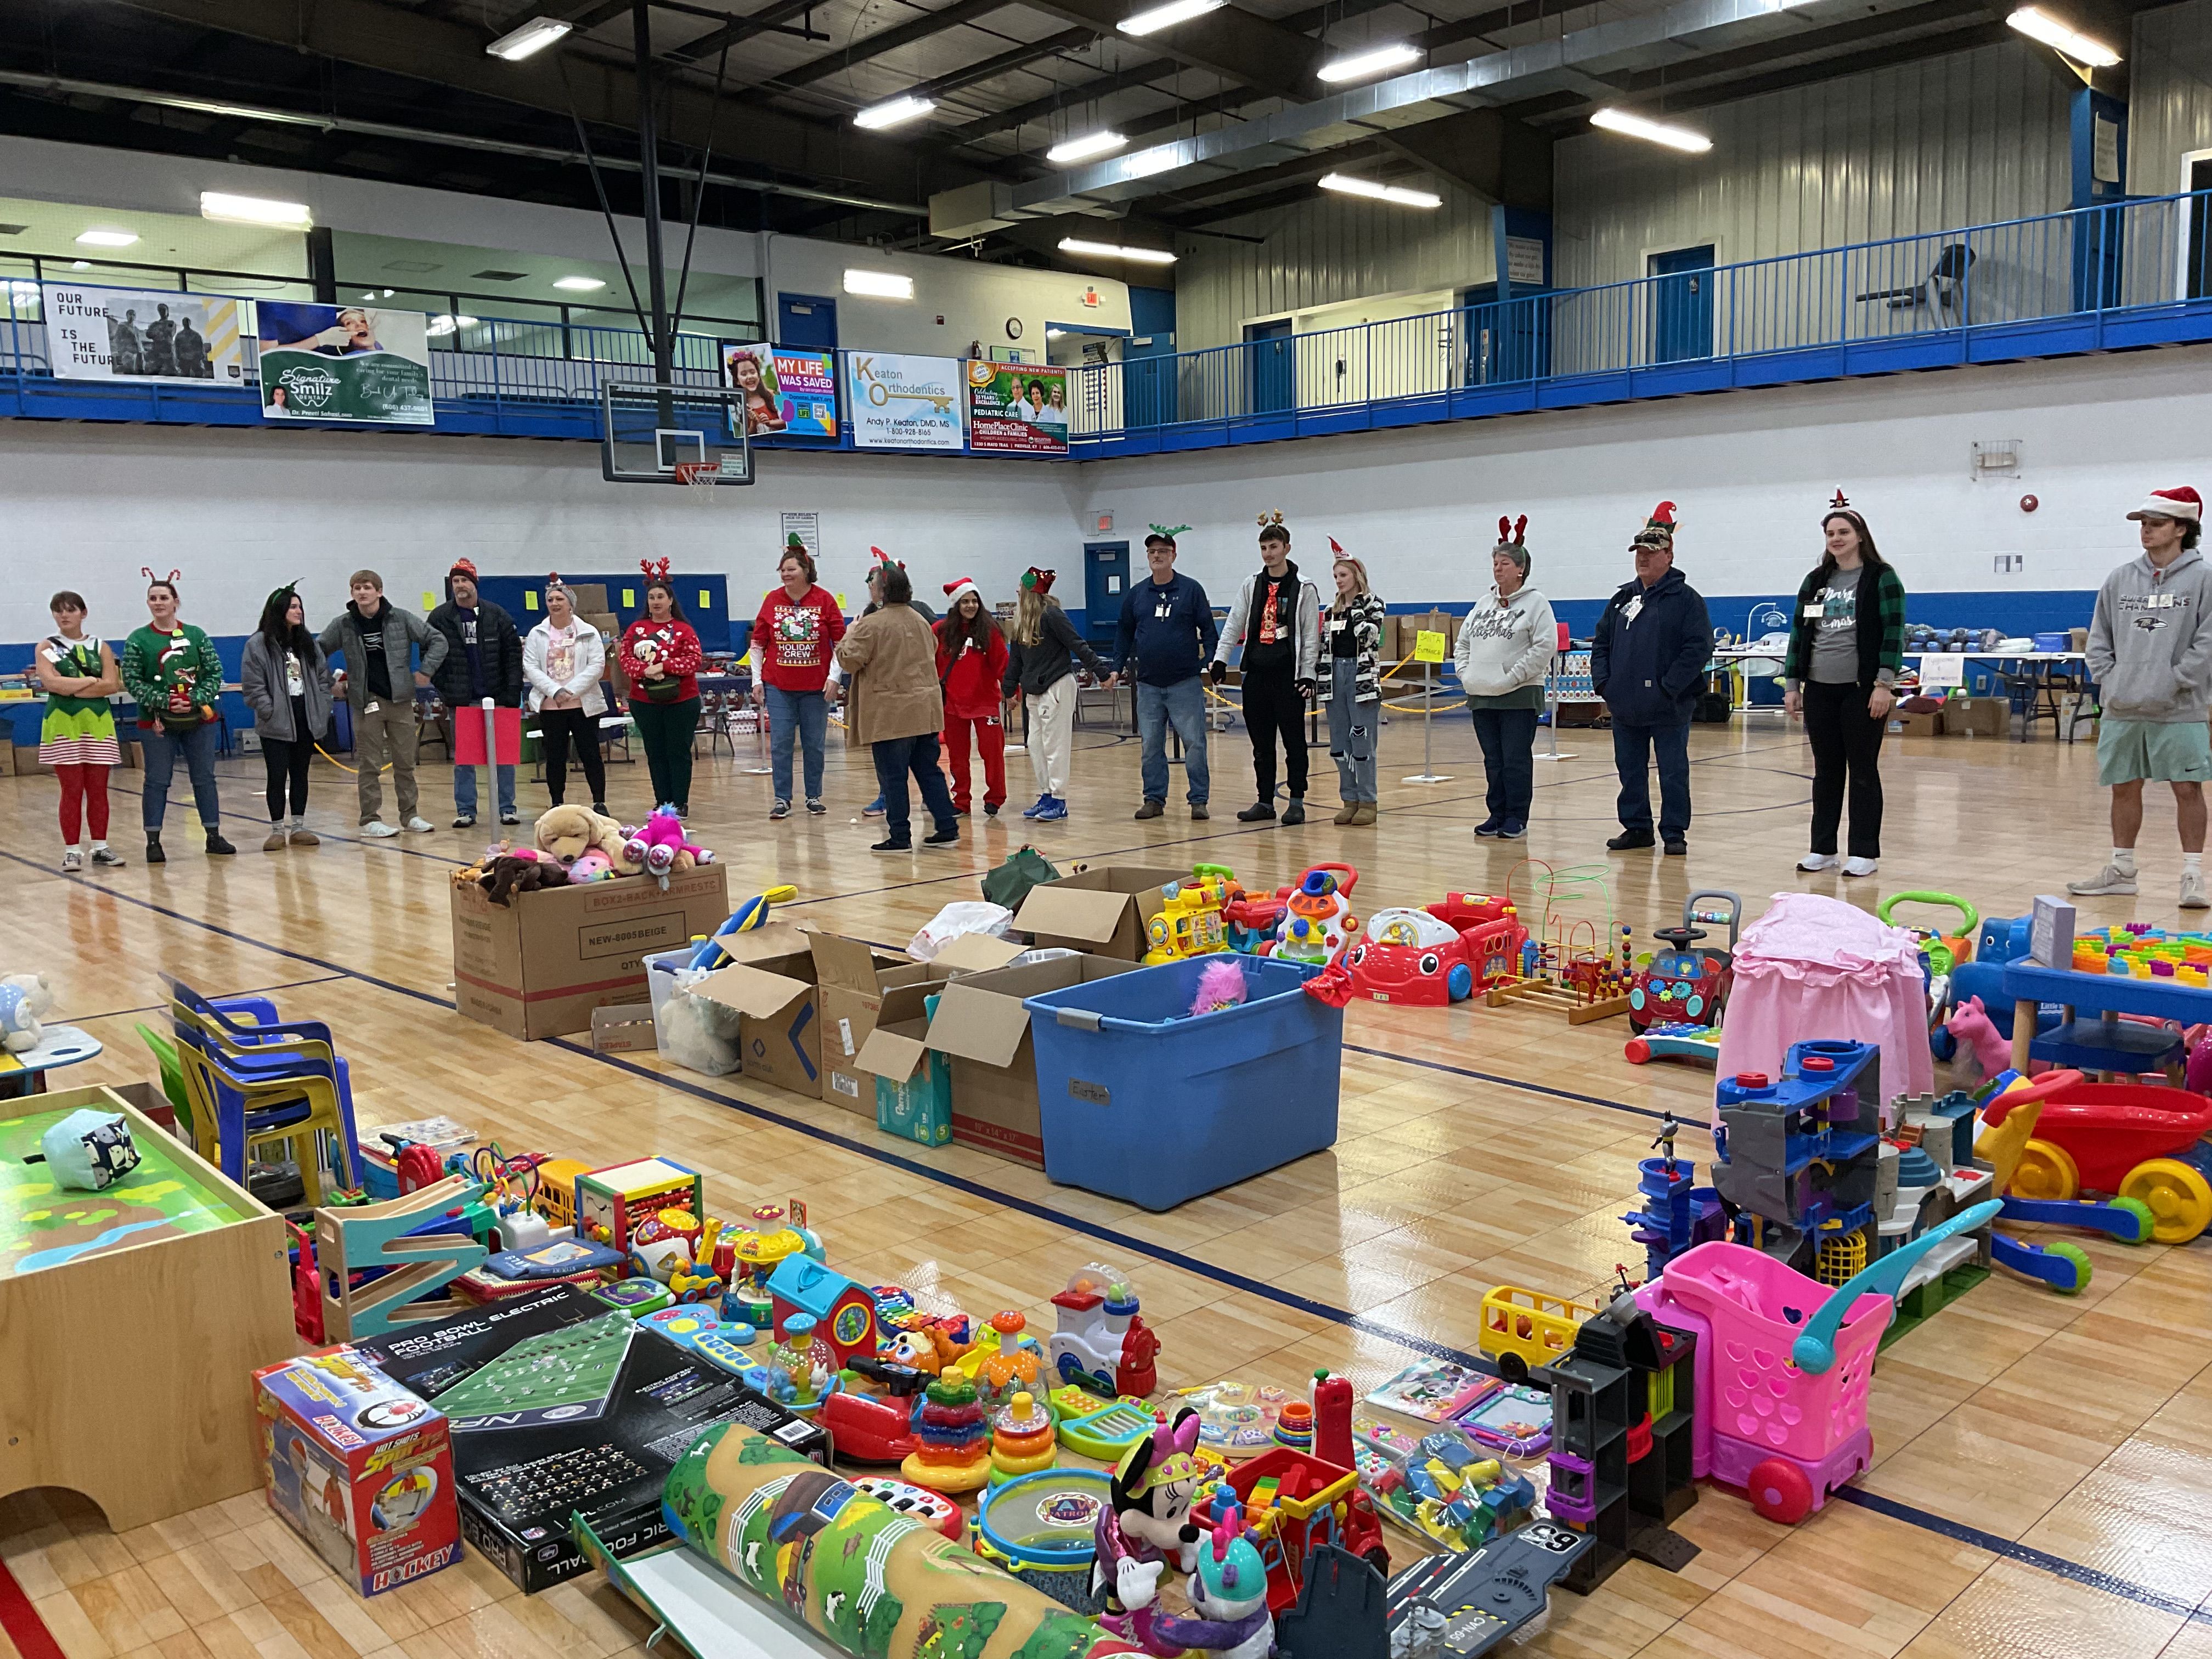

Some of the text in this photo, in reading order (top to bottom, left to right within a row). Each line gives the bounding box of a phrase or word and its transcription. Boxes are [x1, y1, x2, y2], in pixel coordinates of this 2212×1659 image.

[57, 292, 82, 303] OUR
[59, 305, 109, 317] FUTURE
[61, 329, 77, 340] IS
[71, 342, 95, 352] THE
[73, 353, 123, 365] FUTURE
[777, 359, 823, 376] MY LIFE
[856, 357, 902, 381] Keaton
[279, 369, 341, 384] Signature
[780, 375, 832, 388] WAS SAVED
[290, 382, 332, 396] Smilz
[869, 382, 945, 406] Orthodontics
[789, 394, 832, 403] DonateLifeKY.org
[974, 409, 1003, 417] PEDIATRIC
[867, 417, 884, 426] Andy
[2119, 597, 2191, 611] CHAMNS
[1421, 633, 1441, 644] SANTA
[1417, 645, 1441, 655] ENTRANCE
[2040, 1002, 2057, 1010] Little
[599, 1040, 633, 1050] STAPLES
[1072, 1081, 1105, 1100] Easter
[940, 1126, 945, 1135] 5
[388, 1291, 569, 1351] PRO BOWL ELECTRIC
[394, 1326, 493, 1356] FOOTBALL
[312, 1414, 366, 1446] HOCKEY
[374, 1431, 420, 1454] HOT SHOTS
[1045, 1499, 1097, 1517] PAW
[483, 1534, 506, 1567] PRO
[373, 1543, 454, 1592] HOCKEY
[1449, 1616, 1486, 1641] CVN-65
